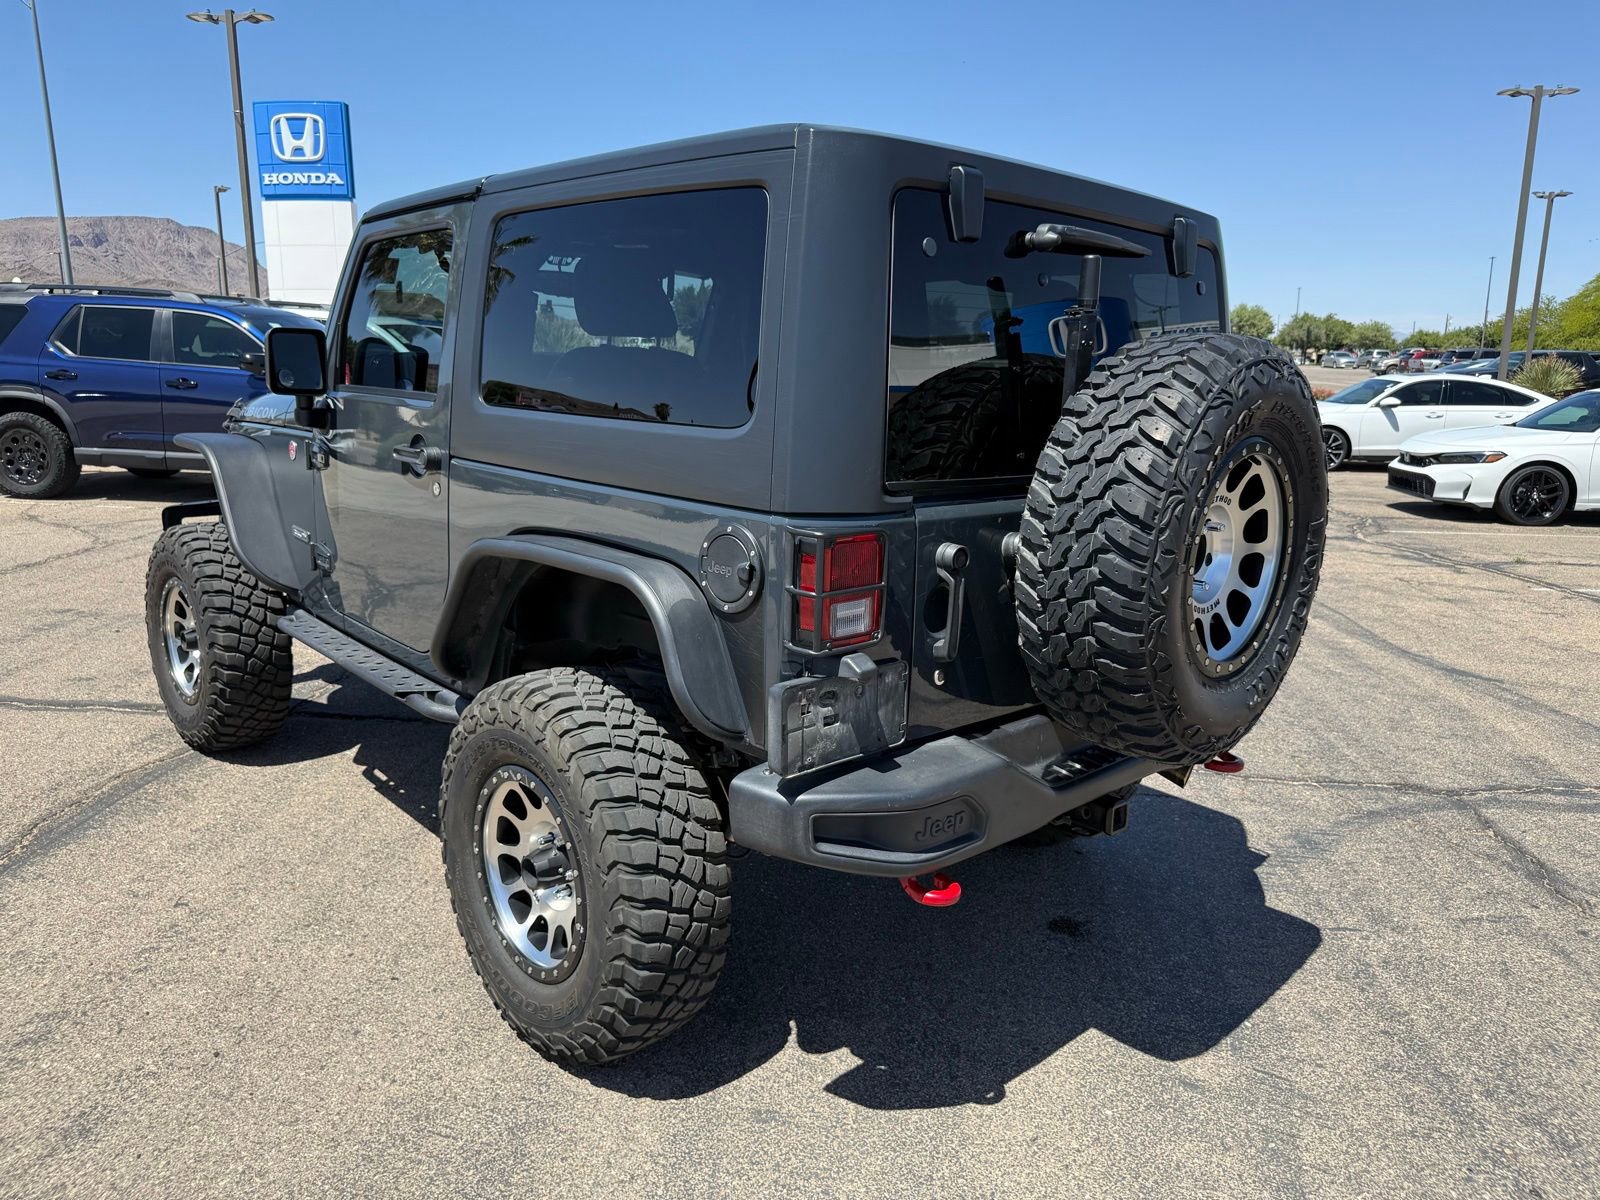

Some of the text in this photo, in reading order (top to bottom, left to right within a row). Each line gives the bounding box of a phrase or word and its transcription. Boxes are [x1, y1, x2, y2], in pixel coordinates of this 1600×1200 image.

[262, 172, 345, 186] HONDA
[707, 560, 732, 578] Jeep
[1193, 597, 1220, 615] METHOD
[914, 809, 967, 841] Jeep
